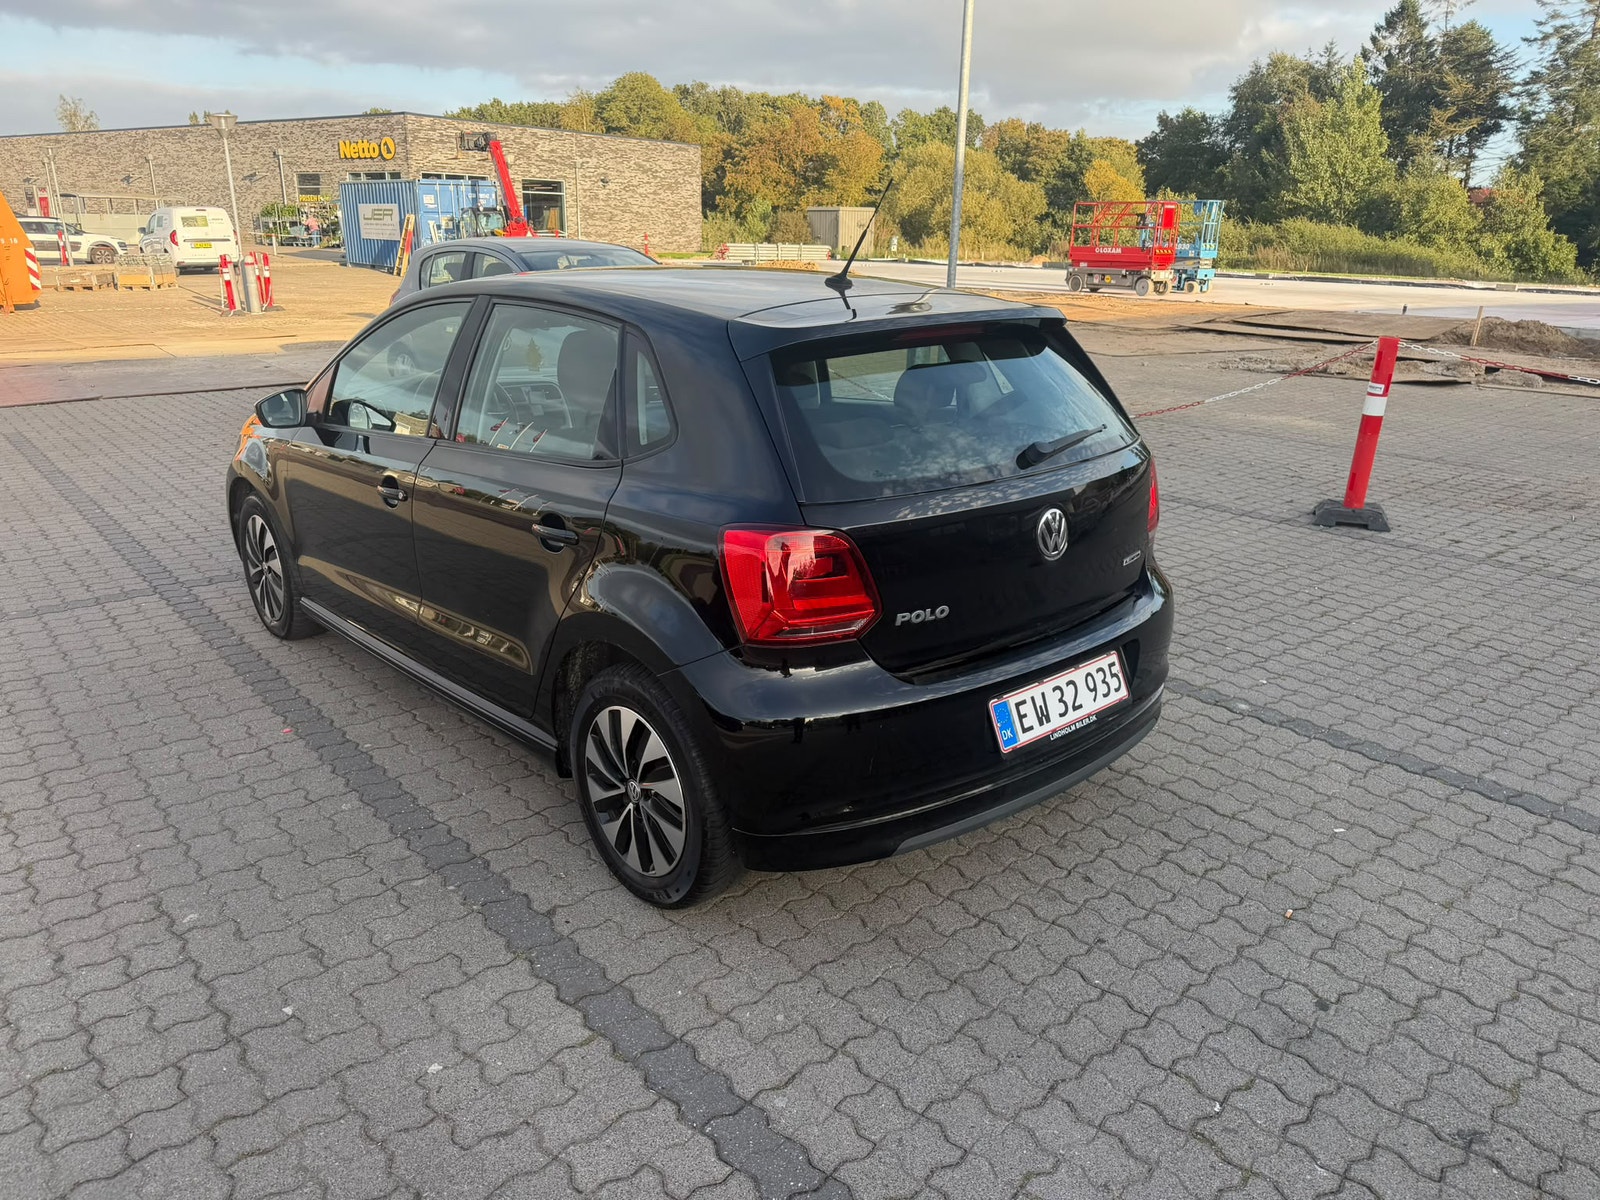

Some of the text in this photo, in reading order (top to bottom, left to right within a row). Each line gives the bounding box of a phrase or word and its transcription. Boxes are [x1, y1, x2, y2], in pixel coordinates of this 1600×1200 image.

[339, 139, 379, 159] Netto
[363, 208, 393, 221] JER
[895, 605, 950, 626] POLO
[1014, 661, 1122, 734] EW 32 935
[1001, 727, 1014, 741] DK
[1049, 714, 1098, 741] LINDHOLM BILER.DK
